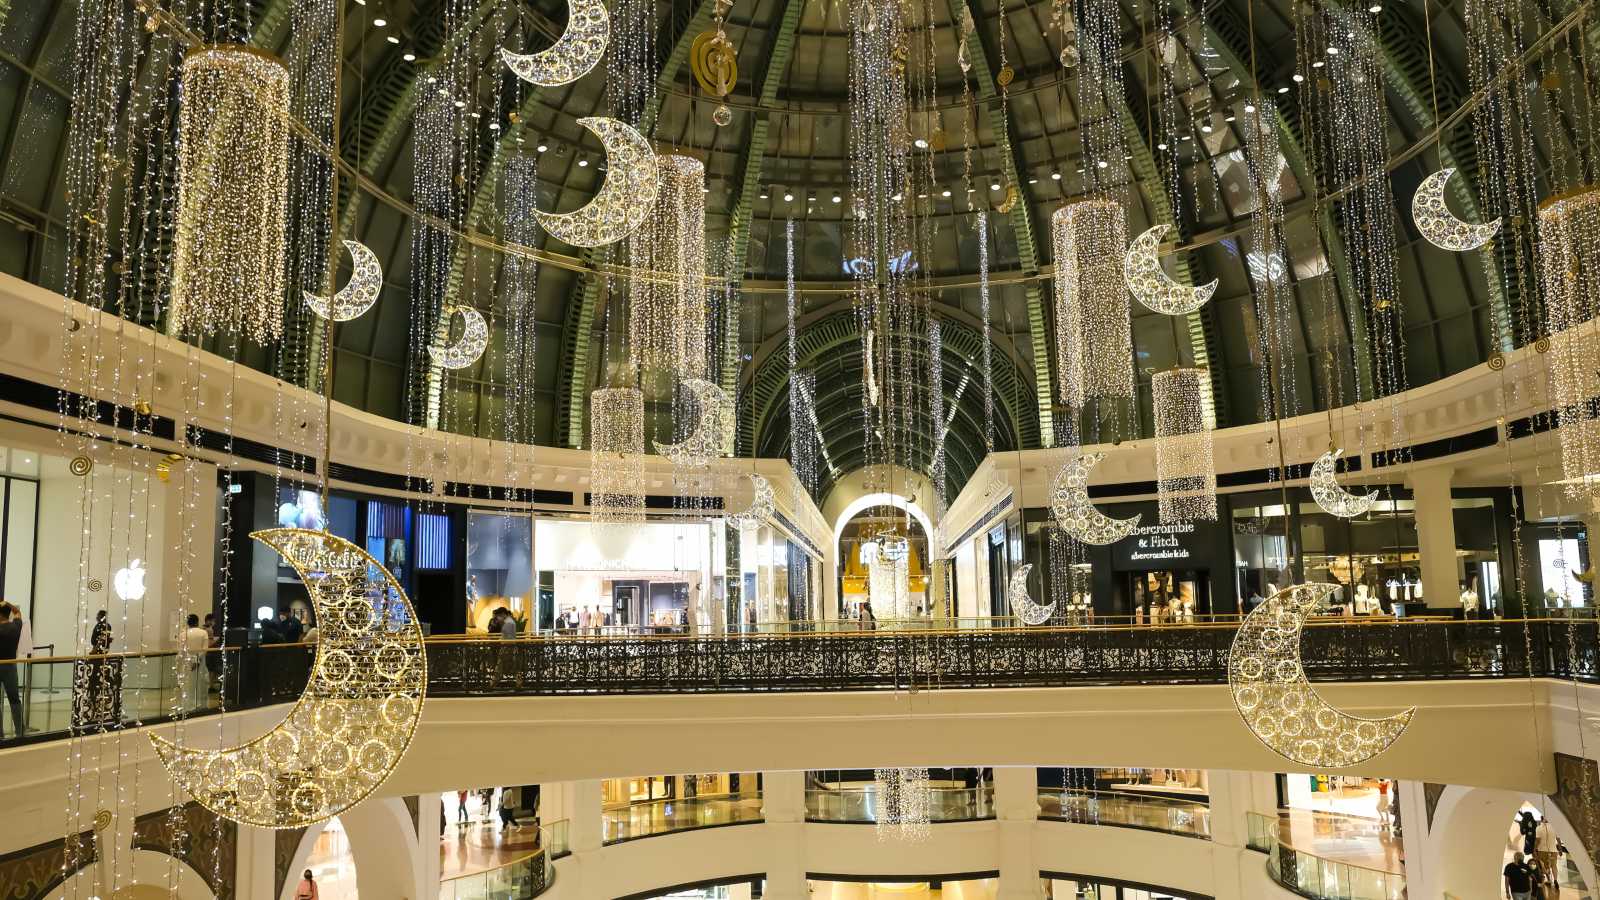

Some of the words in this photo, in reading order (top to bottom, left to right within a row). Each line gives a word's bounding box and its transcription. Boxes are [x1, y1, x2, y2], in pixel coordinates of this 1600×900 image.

[1138, 539, 1148, 548] &
[1150, 534, 1179, 547] Fitch
[1173, 548, 1190, 558] kids
